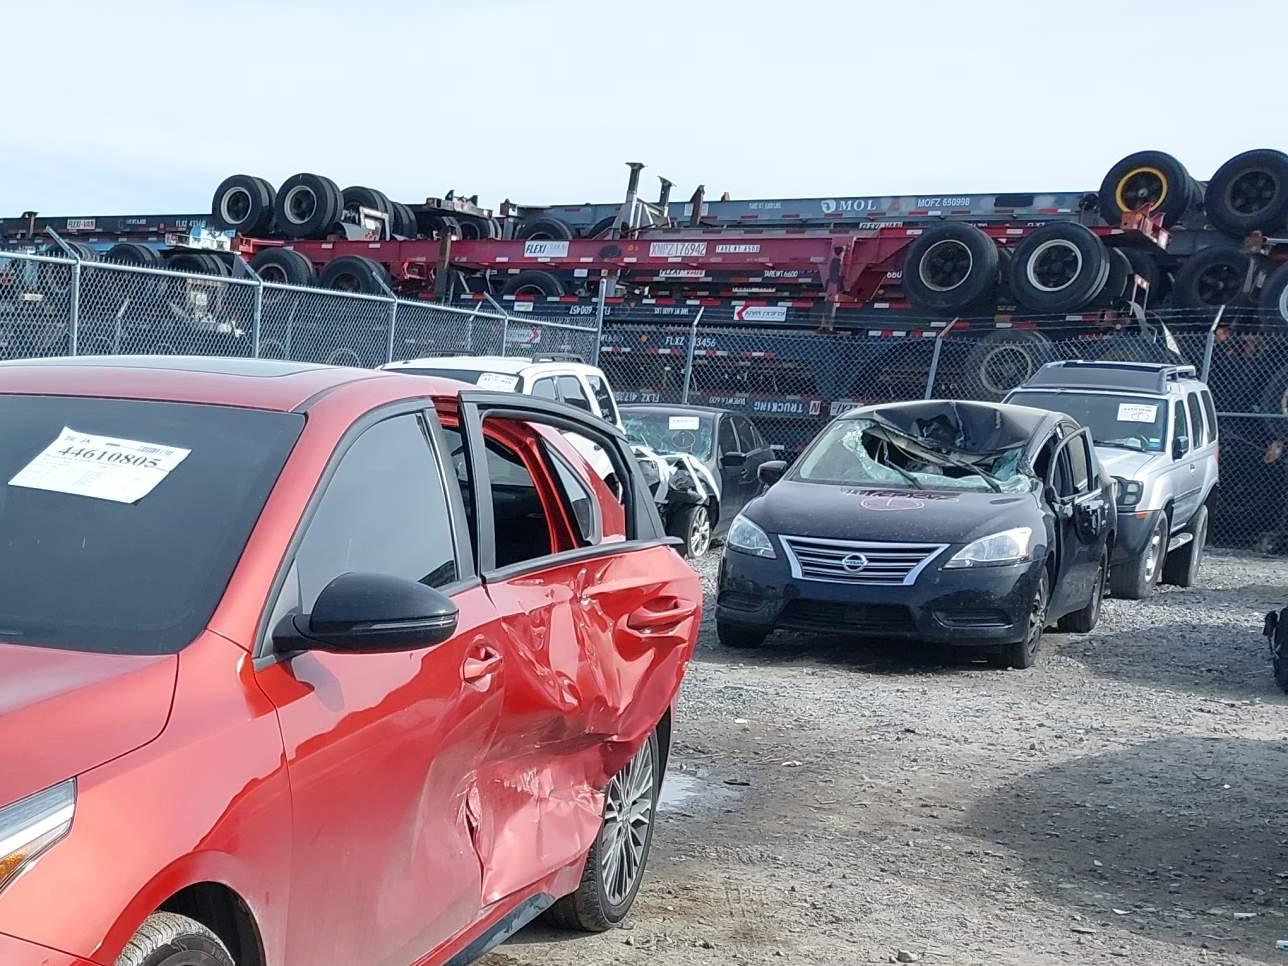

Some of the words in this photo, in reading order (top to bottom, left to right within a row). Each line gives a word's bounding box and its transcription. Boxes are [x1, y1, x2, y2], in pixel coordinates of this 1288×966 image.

[838, 199, 877, 211] MOL
[665, 336, 685, 346] FLXZ
[694, 337, 716, 347] 3456
[753, 401, 803, 413] TRUCKING
[58, 446, 161, 469] 44610805
